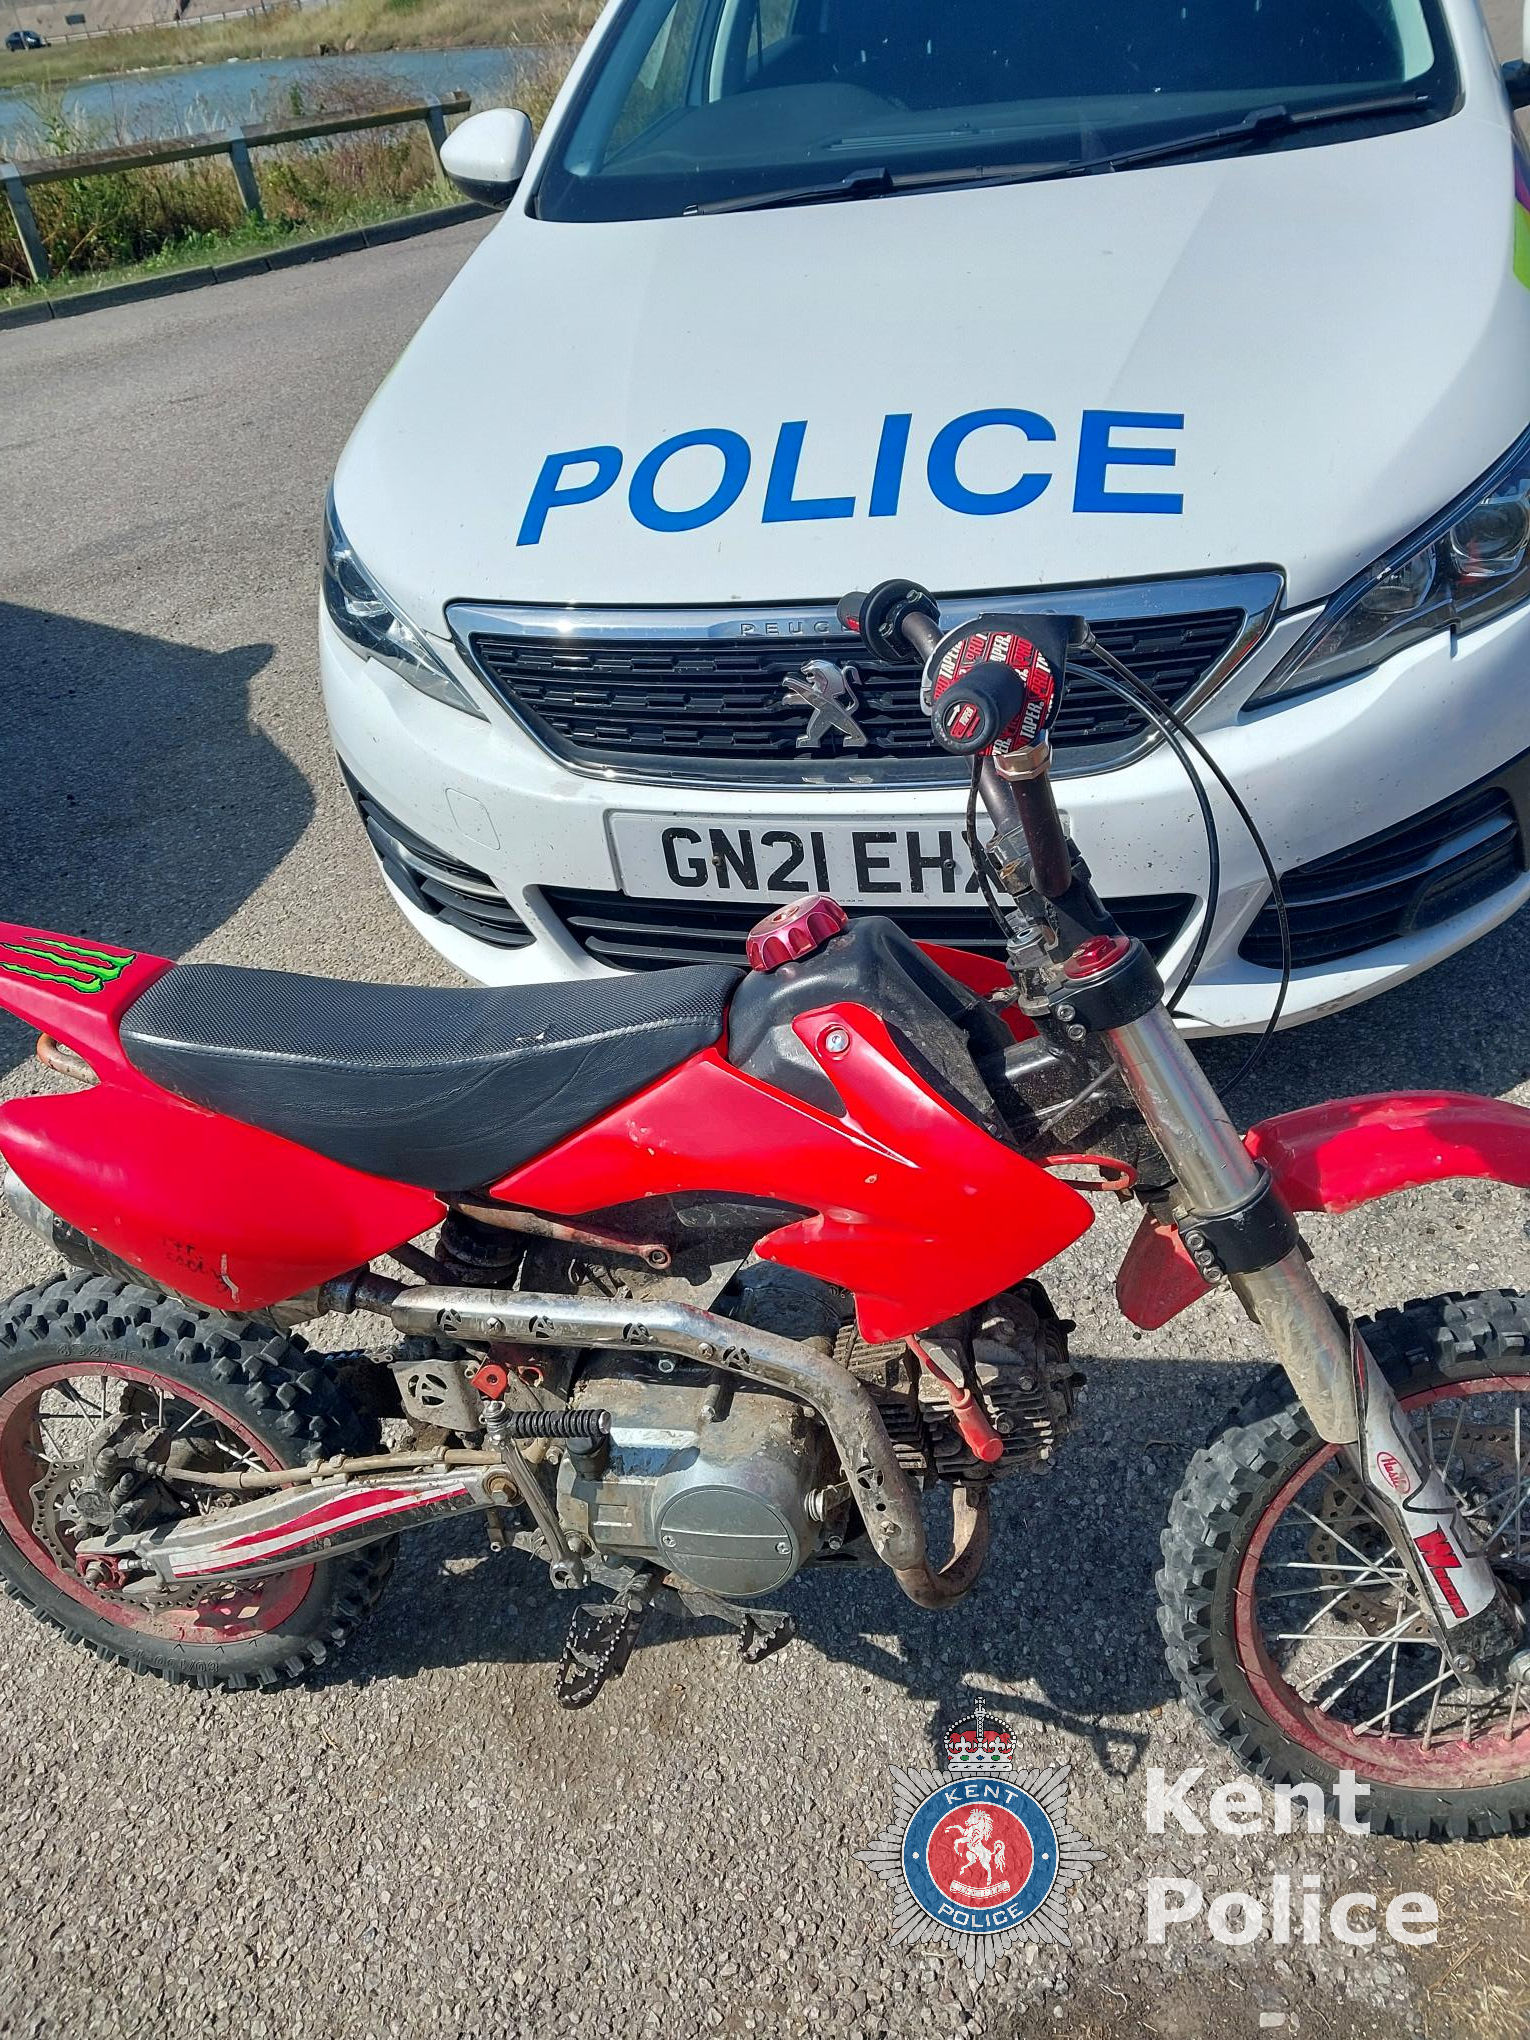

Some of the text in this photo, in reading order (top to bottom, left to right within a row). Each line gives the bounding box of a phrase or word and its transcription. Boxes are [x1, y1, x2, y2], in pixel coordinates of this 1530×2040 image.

[518, 409, 1184, 545] POLICE
[740, 621, 859, 636] PEUG
[661, 827, 830, 893] GN21
